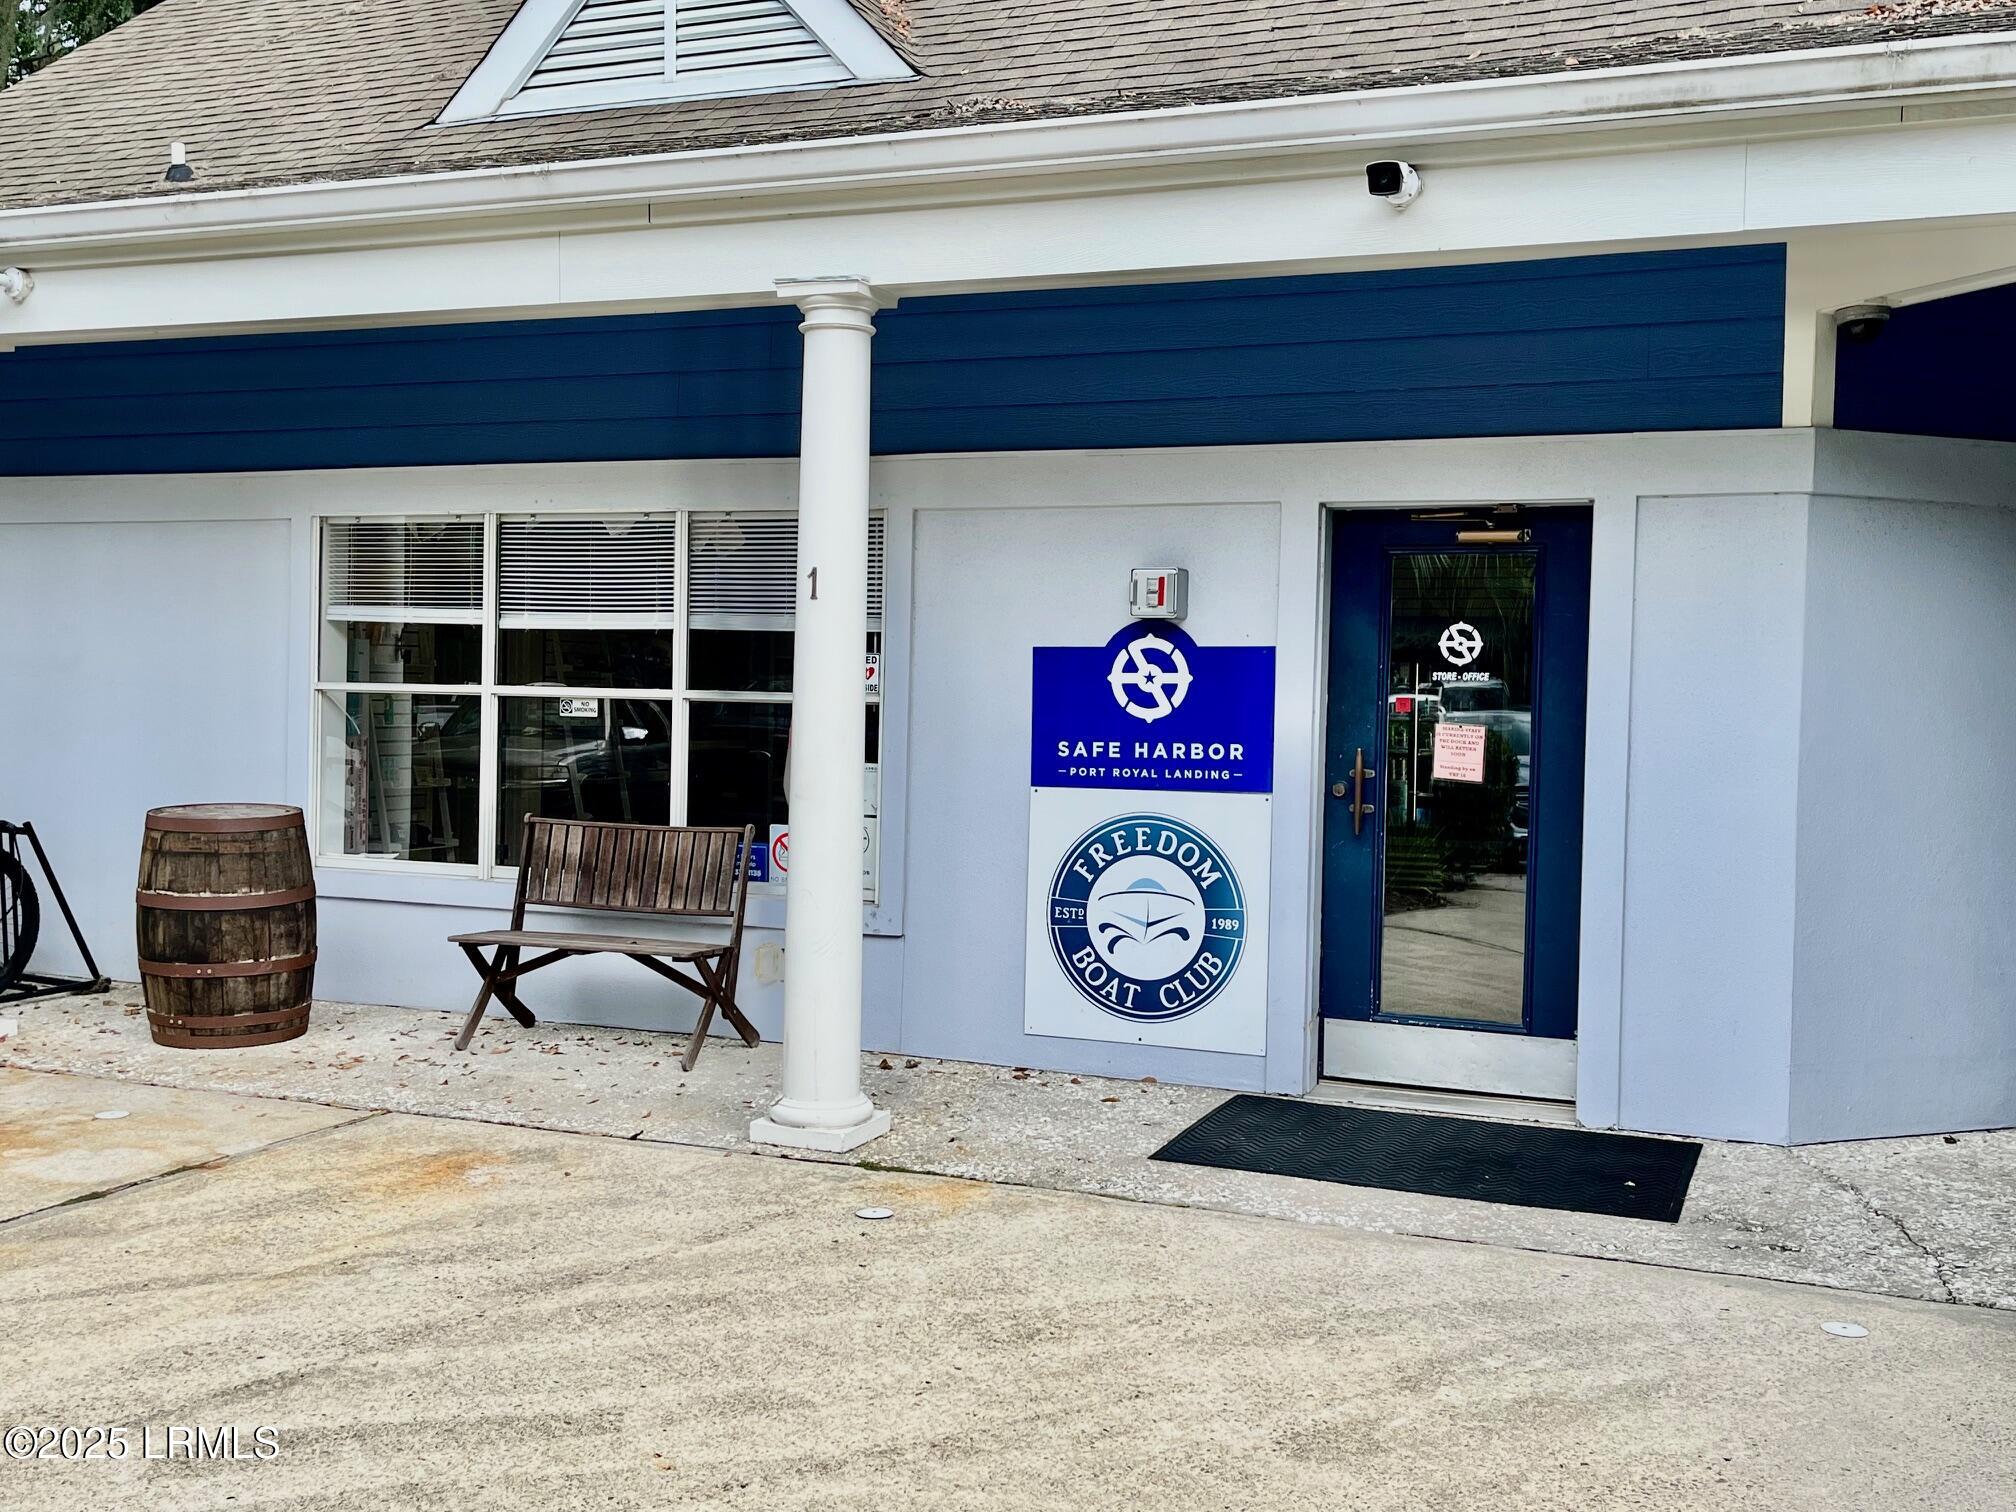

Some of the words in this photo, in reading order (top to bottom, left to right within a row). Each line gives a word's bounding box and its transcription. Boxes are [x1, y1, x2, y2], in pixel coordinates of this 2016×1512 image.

[807, 566, 818, 601] 1
[1432, 672, 1457, 681] STORE
[1462, 672, 1490, 681] OFFICE
[1058, 741, 1121, 758] SAFE
[1134, 742, 1244, 760] HARBOR
[1070, 768, 1106, 777] PORT
[1112, 768, 1158, 778] ROYAL
[1165, 769, 1230, 780] LANDING
[1073, 827, 1223, 890] FREEDOM
[1212, 918, 1240, 930] 1989
[1072, 945, 1141, 1008] BOAT
[1159, 951, 1223, 1008] CLUB
